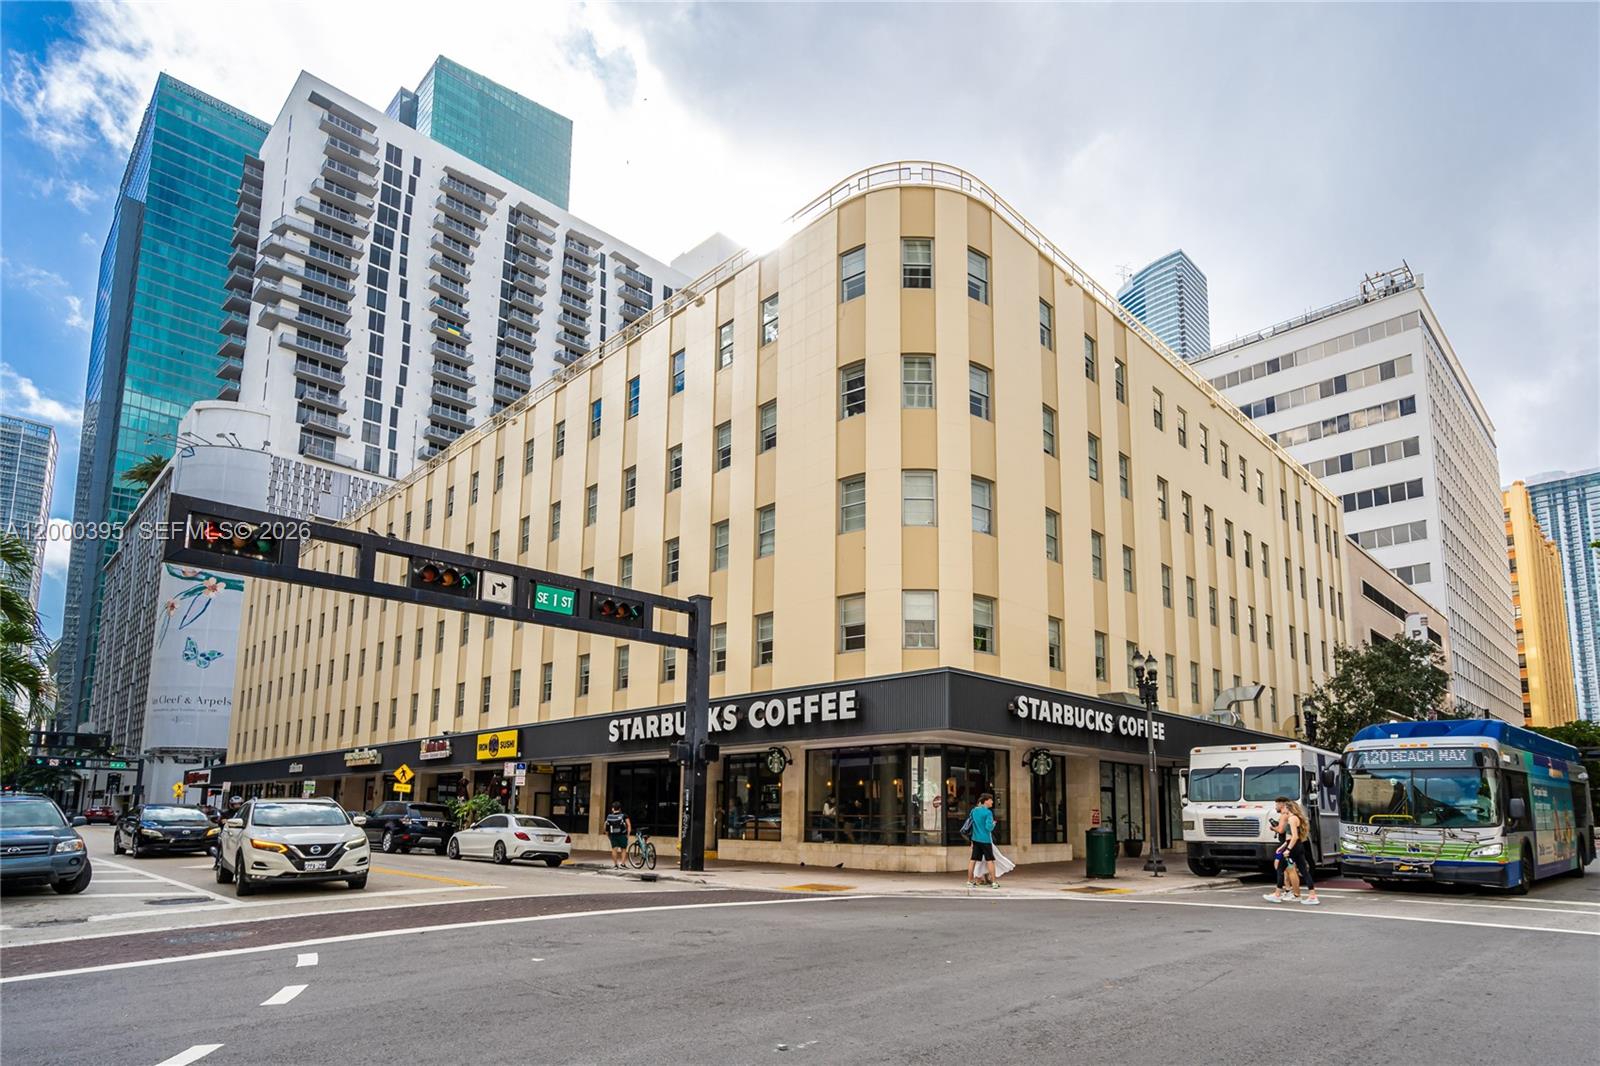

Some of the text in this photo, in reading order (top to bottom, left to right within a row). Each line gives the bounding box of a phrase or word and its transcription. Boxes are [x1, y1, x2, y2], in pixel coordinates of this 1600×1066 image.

[537, 591, 572, 608] SE 1 ST
[184, 696, 193, 705] &
[197, 695, 232, 708] Arpels
[608, 689, 857, 743] STARBUKS COFFEE
[1017, 695, 1113, 733] STARBUCKS
[1363, 749, 1467, 765] 120 BEACH MAX
[1346, 825, 1369, 833] 18193
